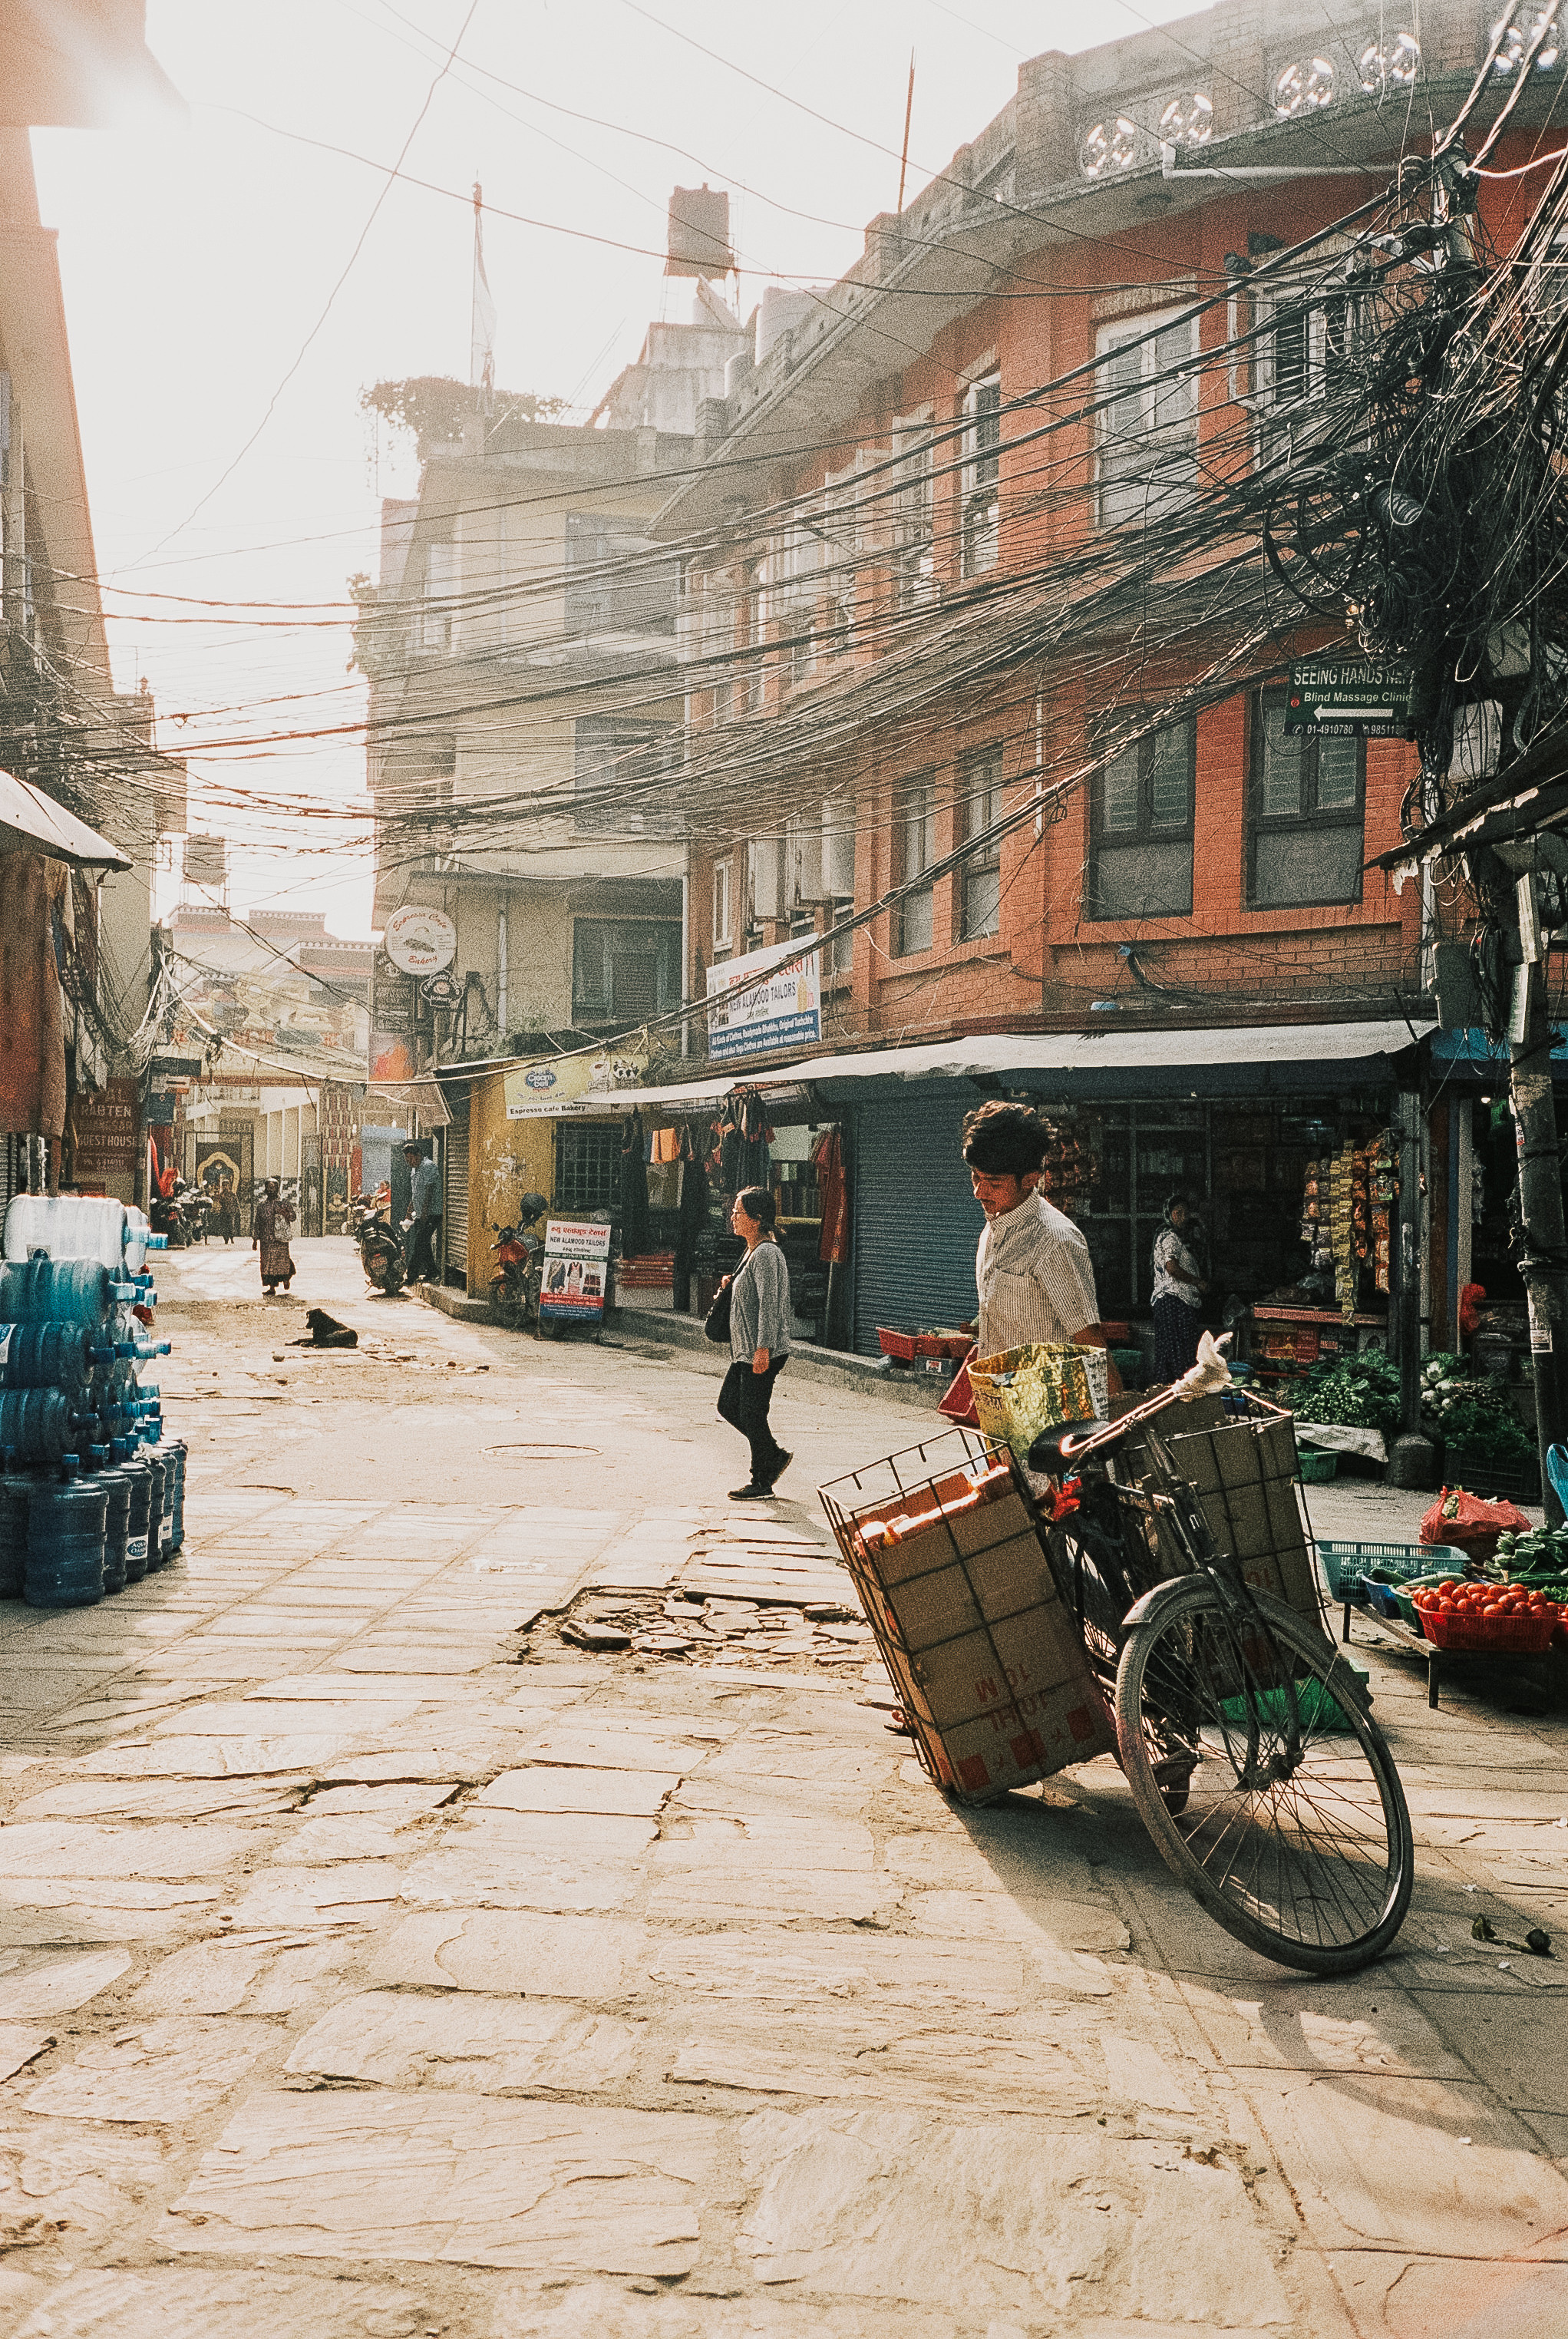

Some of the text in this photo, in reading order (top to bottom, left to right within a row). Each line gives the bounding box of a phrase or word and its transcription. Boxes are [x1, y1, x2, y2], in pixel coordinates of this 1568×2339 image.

[1294, 666, 1338, 686] SEEING
[1341, 666, 1382, 685] HANDS
[1304, 692, 1411, 703] Blind Massage Clinic
[1307, 725, 1353, 735] 01-4910780
[729, 998, 742, 1013] NEW
[771, 982, 797, 1001] TAILORS
[510, 1106, 542, 1115] Espresso
[561, 1104, 586, 1112] Bakery
[78, 1135, 105, 1146] GUEST
[586, 1238, 606, 1247] TAILORS
